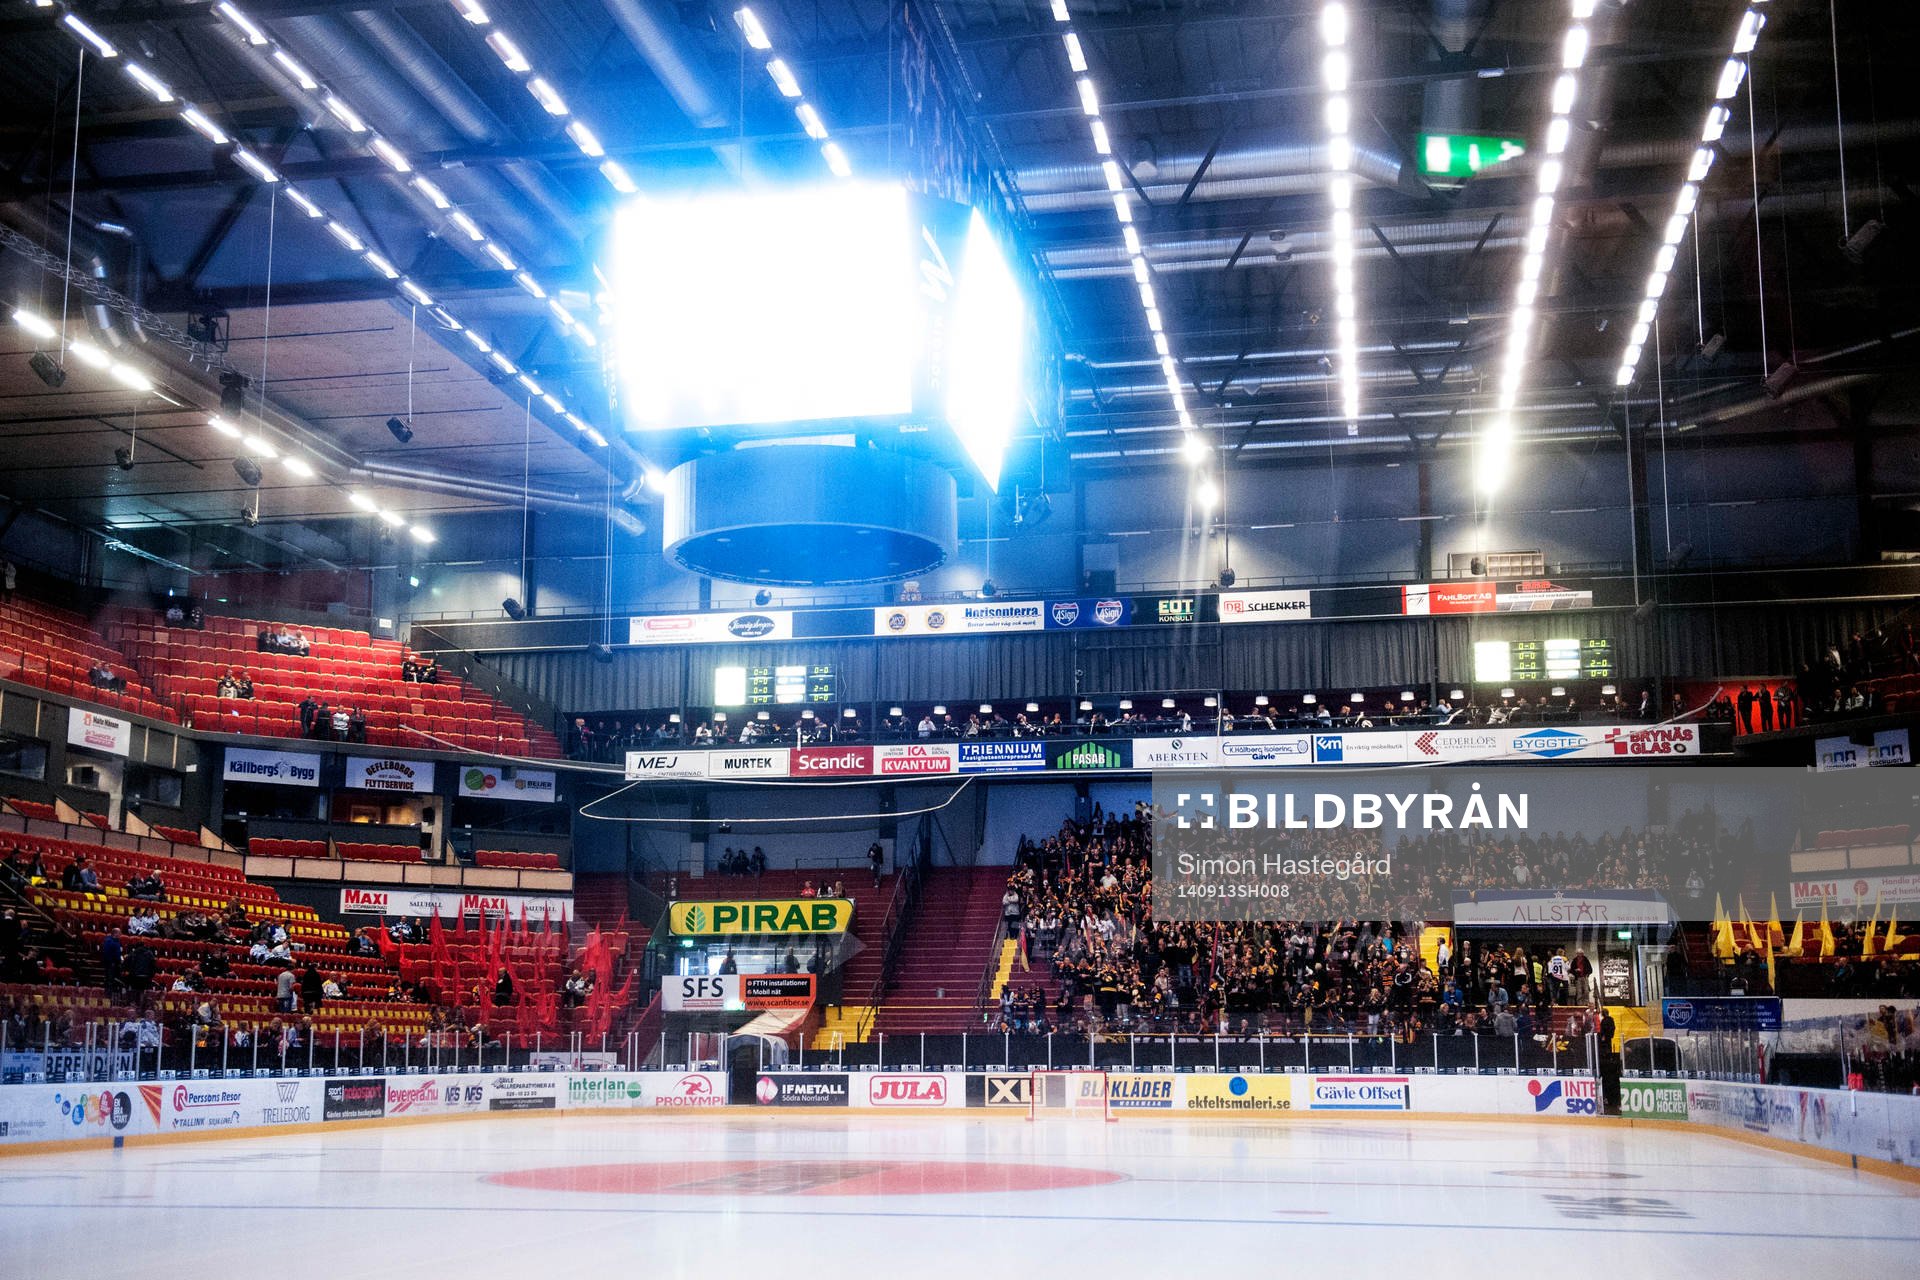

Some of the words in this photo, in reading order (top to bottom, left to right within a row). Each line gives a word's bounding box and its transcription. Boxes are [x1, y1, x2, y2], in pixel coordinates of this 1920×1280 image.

[965, 607, 1038, 617] Horisonterra
[1248, 602, 1306, 612] SCHENKER
[1519, 642, 1536, 650] 0-0
[1436, 736, 1496, 745] CEDERLÖFS
[908, 746, 927, 756] ICA
[962, 744, 1042, 755] TRIENNIUM
[1630, 742, 1672, 754] GLAS
[638, 757, 678, 769] MEJ
[798, 753, 865, 770] Scandic
[1073, 754, 1105, 764] PASAB
[1147, 752, 1208, 762] ABERSTEN
[724, 758, 772, 769] MURTEK
[884, 759, 947, 771] KVANTUM
[230, 760, 279, 777] Källbergs
[290, 765, 315, 780] Bygg
[365, 779, 414, 790] FLYTTSERVICE
[345, 889, 388, 905] MAXI
[464, 895, 505, 909] MAXI
[1513, 902, 1607, 921] ALLSTAR
[713, 904, 837, 932] PIRAB
[1553, 966, 1563, 974] 91
[682, 977, 724, 998] SFS
[747, 999, 810, 1007] www.scanfiber.se
[569, 1078, 625, 1090] interlan
[782, 1085, 845, 1094] IFMETALL
[387, 1086, 438, 1102] leverera.nu
[873, 1081, 944, 1100] JULA
[1317, 1086, 1355, 1100] Gävle
[1359, 1085, 1402, 1099] Offset
[1656, 1089, 1682, 1100] METER
[189, 1092, 219, 1103] Perssons
[222, 1091, 241, 1101] Resor
[1188, 1096, 1290, 1109] ekfeltsmaleri.se
[1621, 1088, 1654, 1112] 200
[1657, 1101, 1686, 1113] HOCKEY
[263, 1106, 310, 1123] TRELLEBORG
[180, 1118, 205, 1127] TALLINK
